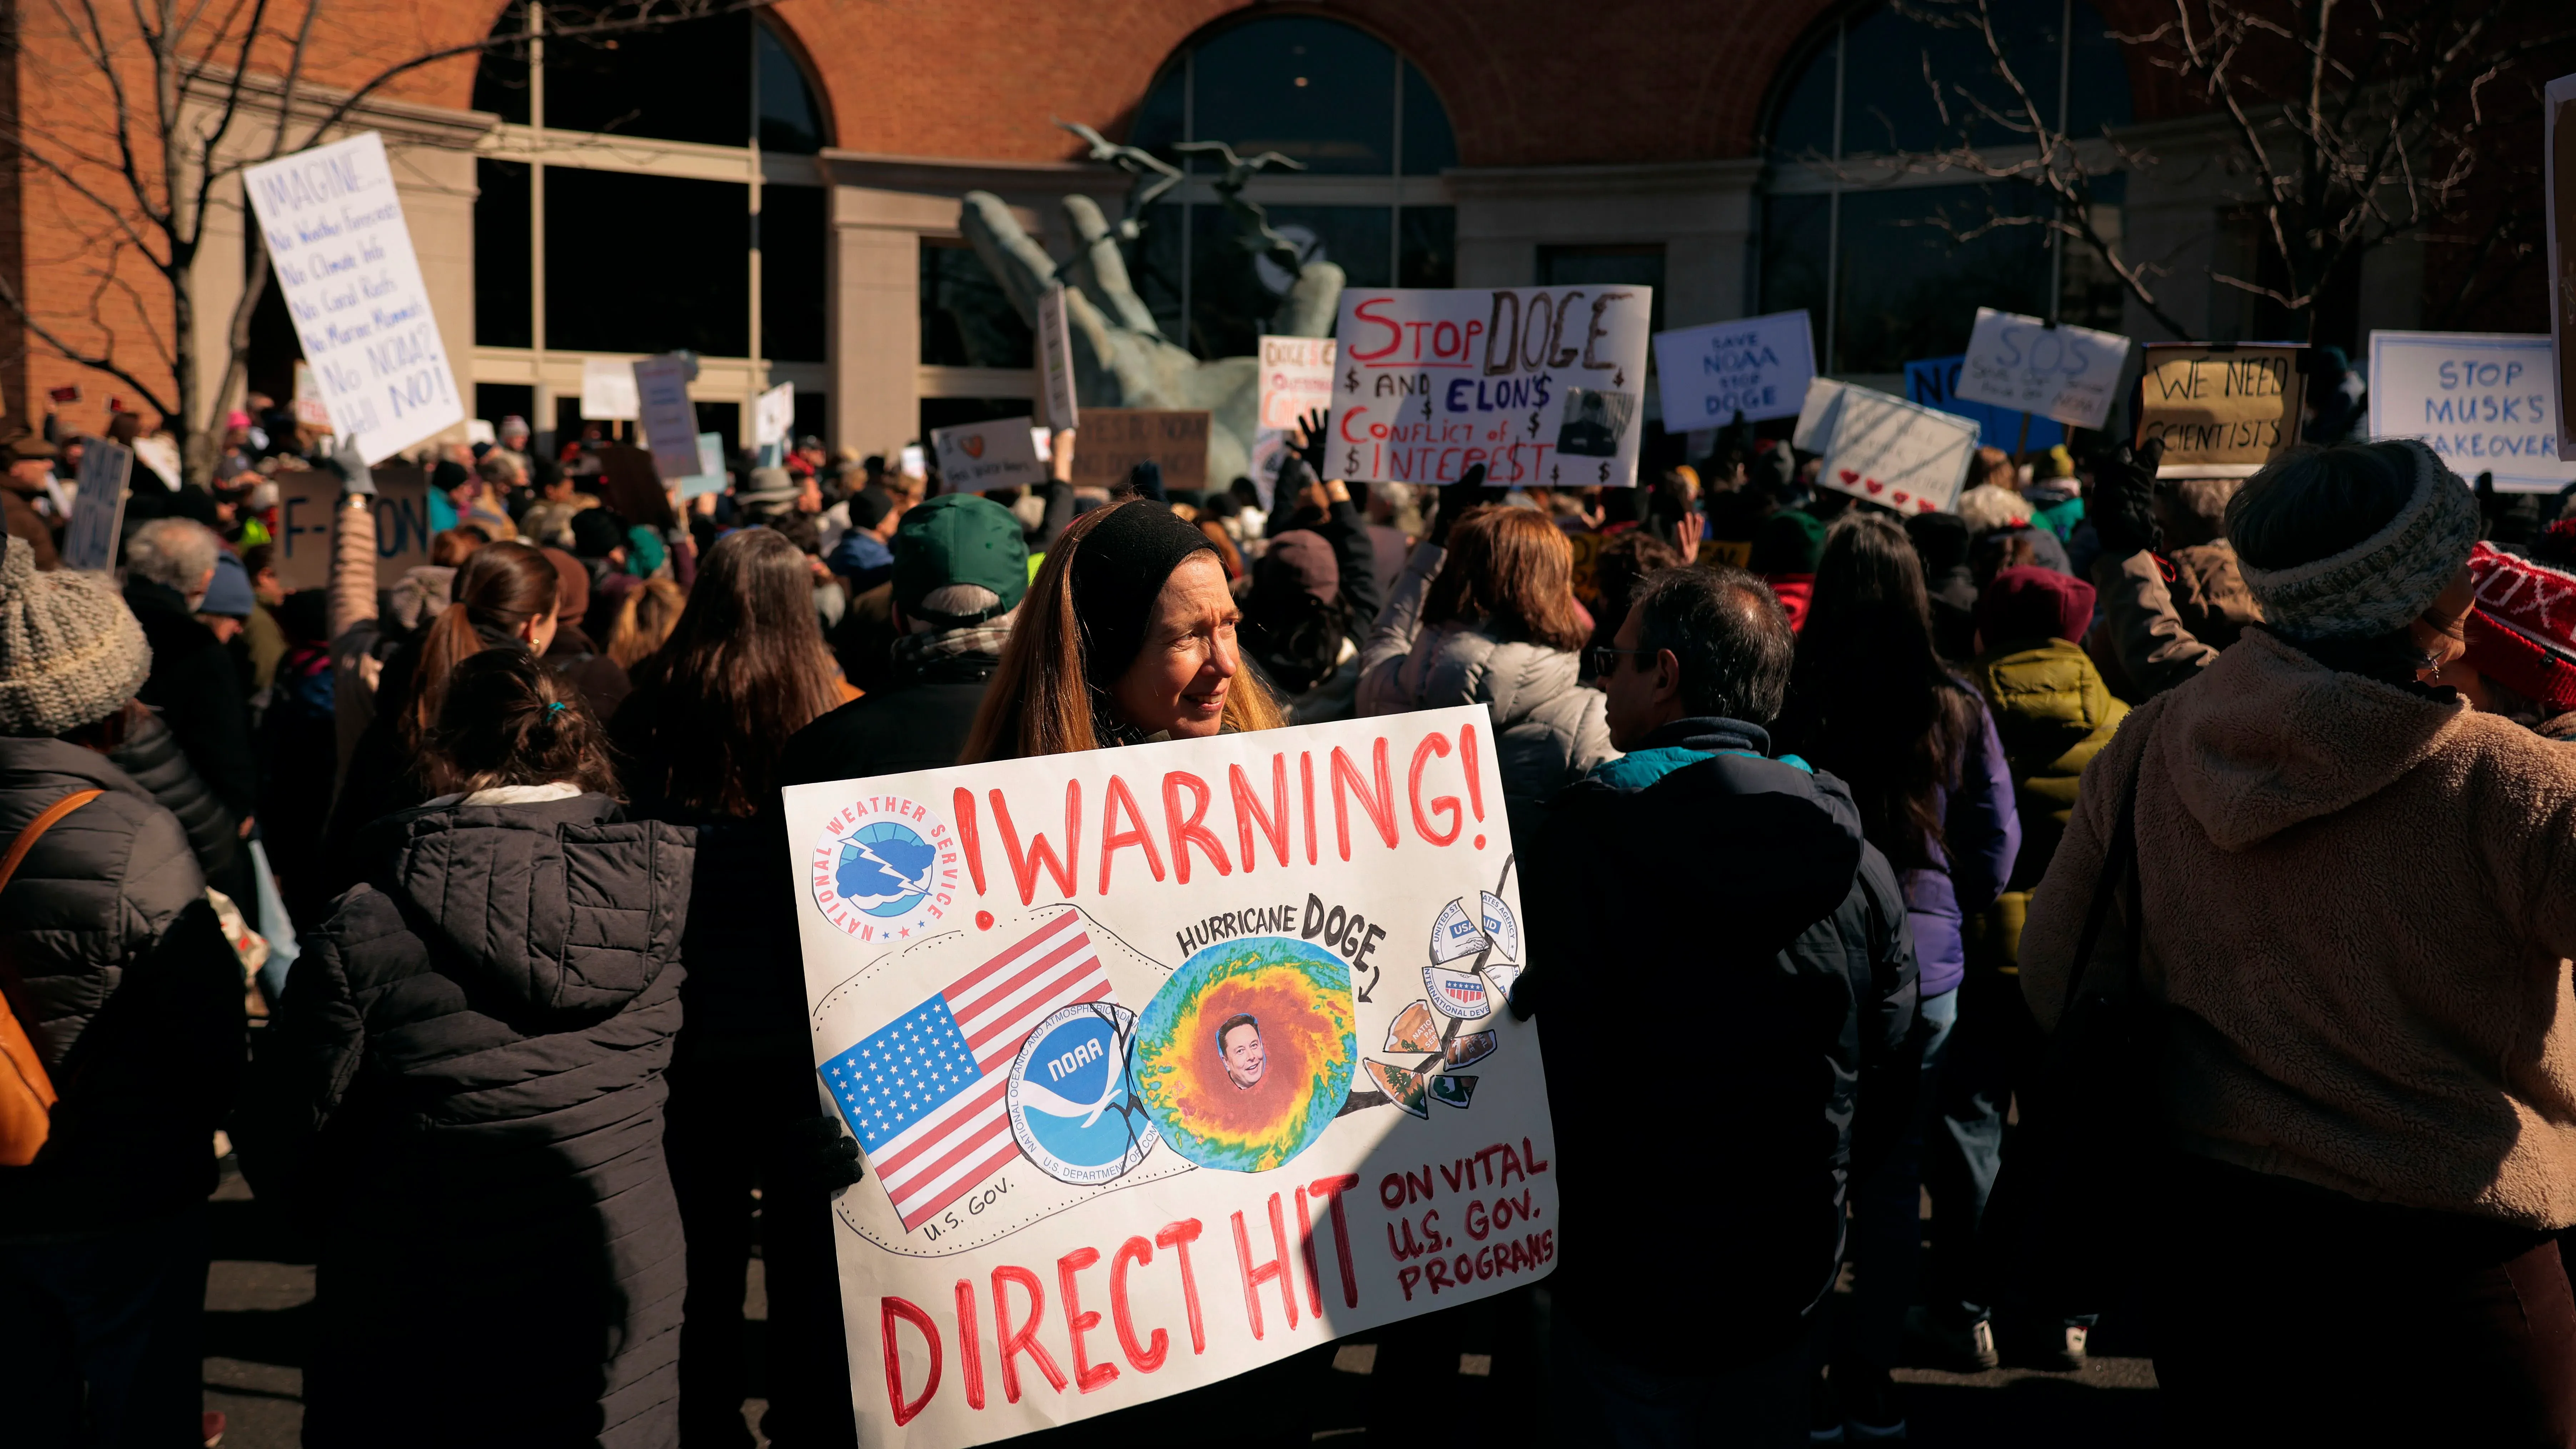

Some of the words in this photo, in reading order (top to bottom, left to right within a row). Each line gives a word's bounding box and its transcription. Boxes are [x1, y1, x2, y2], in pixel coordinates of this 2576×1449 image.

[280, 261, 306, 287] No
[291, 296, 319, 321] No
[1484, 291, 1634, 377] DOGE
[1711, 331, 1759, 350] SAVE
[1996, 326, 2091, 376] SOS
[323, 358, 362, 397] No
[1703, 345, 1780, 376] NOAA
[2153, 356, 2210, 401] WE
[2225, 356, 2288, 397] NEED
[2439, 360, 2523, 390] STOP
[388, 364, 451, 419] NO!
[1376, 373, 1430, 397] AND
[1705, 384, 1777, 415] DOGE
[2146, 418, 2281, 452] SCIENTISTS
[826, 796, 926, 836] WEATHER
[927, 824, 958, 920] SERVICE
[814, 848, 874, 941] NATIONAL
[1176, 904, 1298, 958] HURRICANE
[1301, 893, 1387, 972] DOGE
[1433, 912, 1449, 943] UNITED
[1499, 907, 1515, 939] AGENCY
[1026, 1027, 1044, 1048] AND
[1045, 1004, 1112, 1030] ATMOSPHERIC
[1010, 1047, 1029, 1097] OCEANIC
[1047, 1038, 1103, 1082] NOAA
[1010, 1100, 1037, 1153] NATIONAL
[1043, 1157, 1059, 1173] U.S.
[1063, 1163, 1127, 1180] DEPARTMENT
[1129, 1149, 1143, 1163] OF
[1379, 1164, 1434, 1211] ON
[1440, 1136, 1548, 1193] VITAL
[924, 1211, 964, 1241] U.S.
[968, 1177, 1014, 1215] GOV.
[1387, 1209, 1452, 1262] U.S.
[1464, 1188, 1540, 1241] GOV.
[1397, 1229, 1554, 1302] PROGRAMS
[881, 1218, 1205, 1426] DIRECT
[1230, 1172, 1360, 1341] HIT
